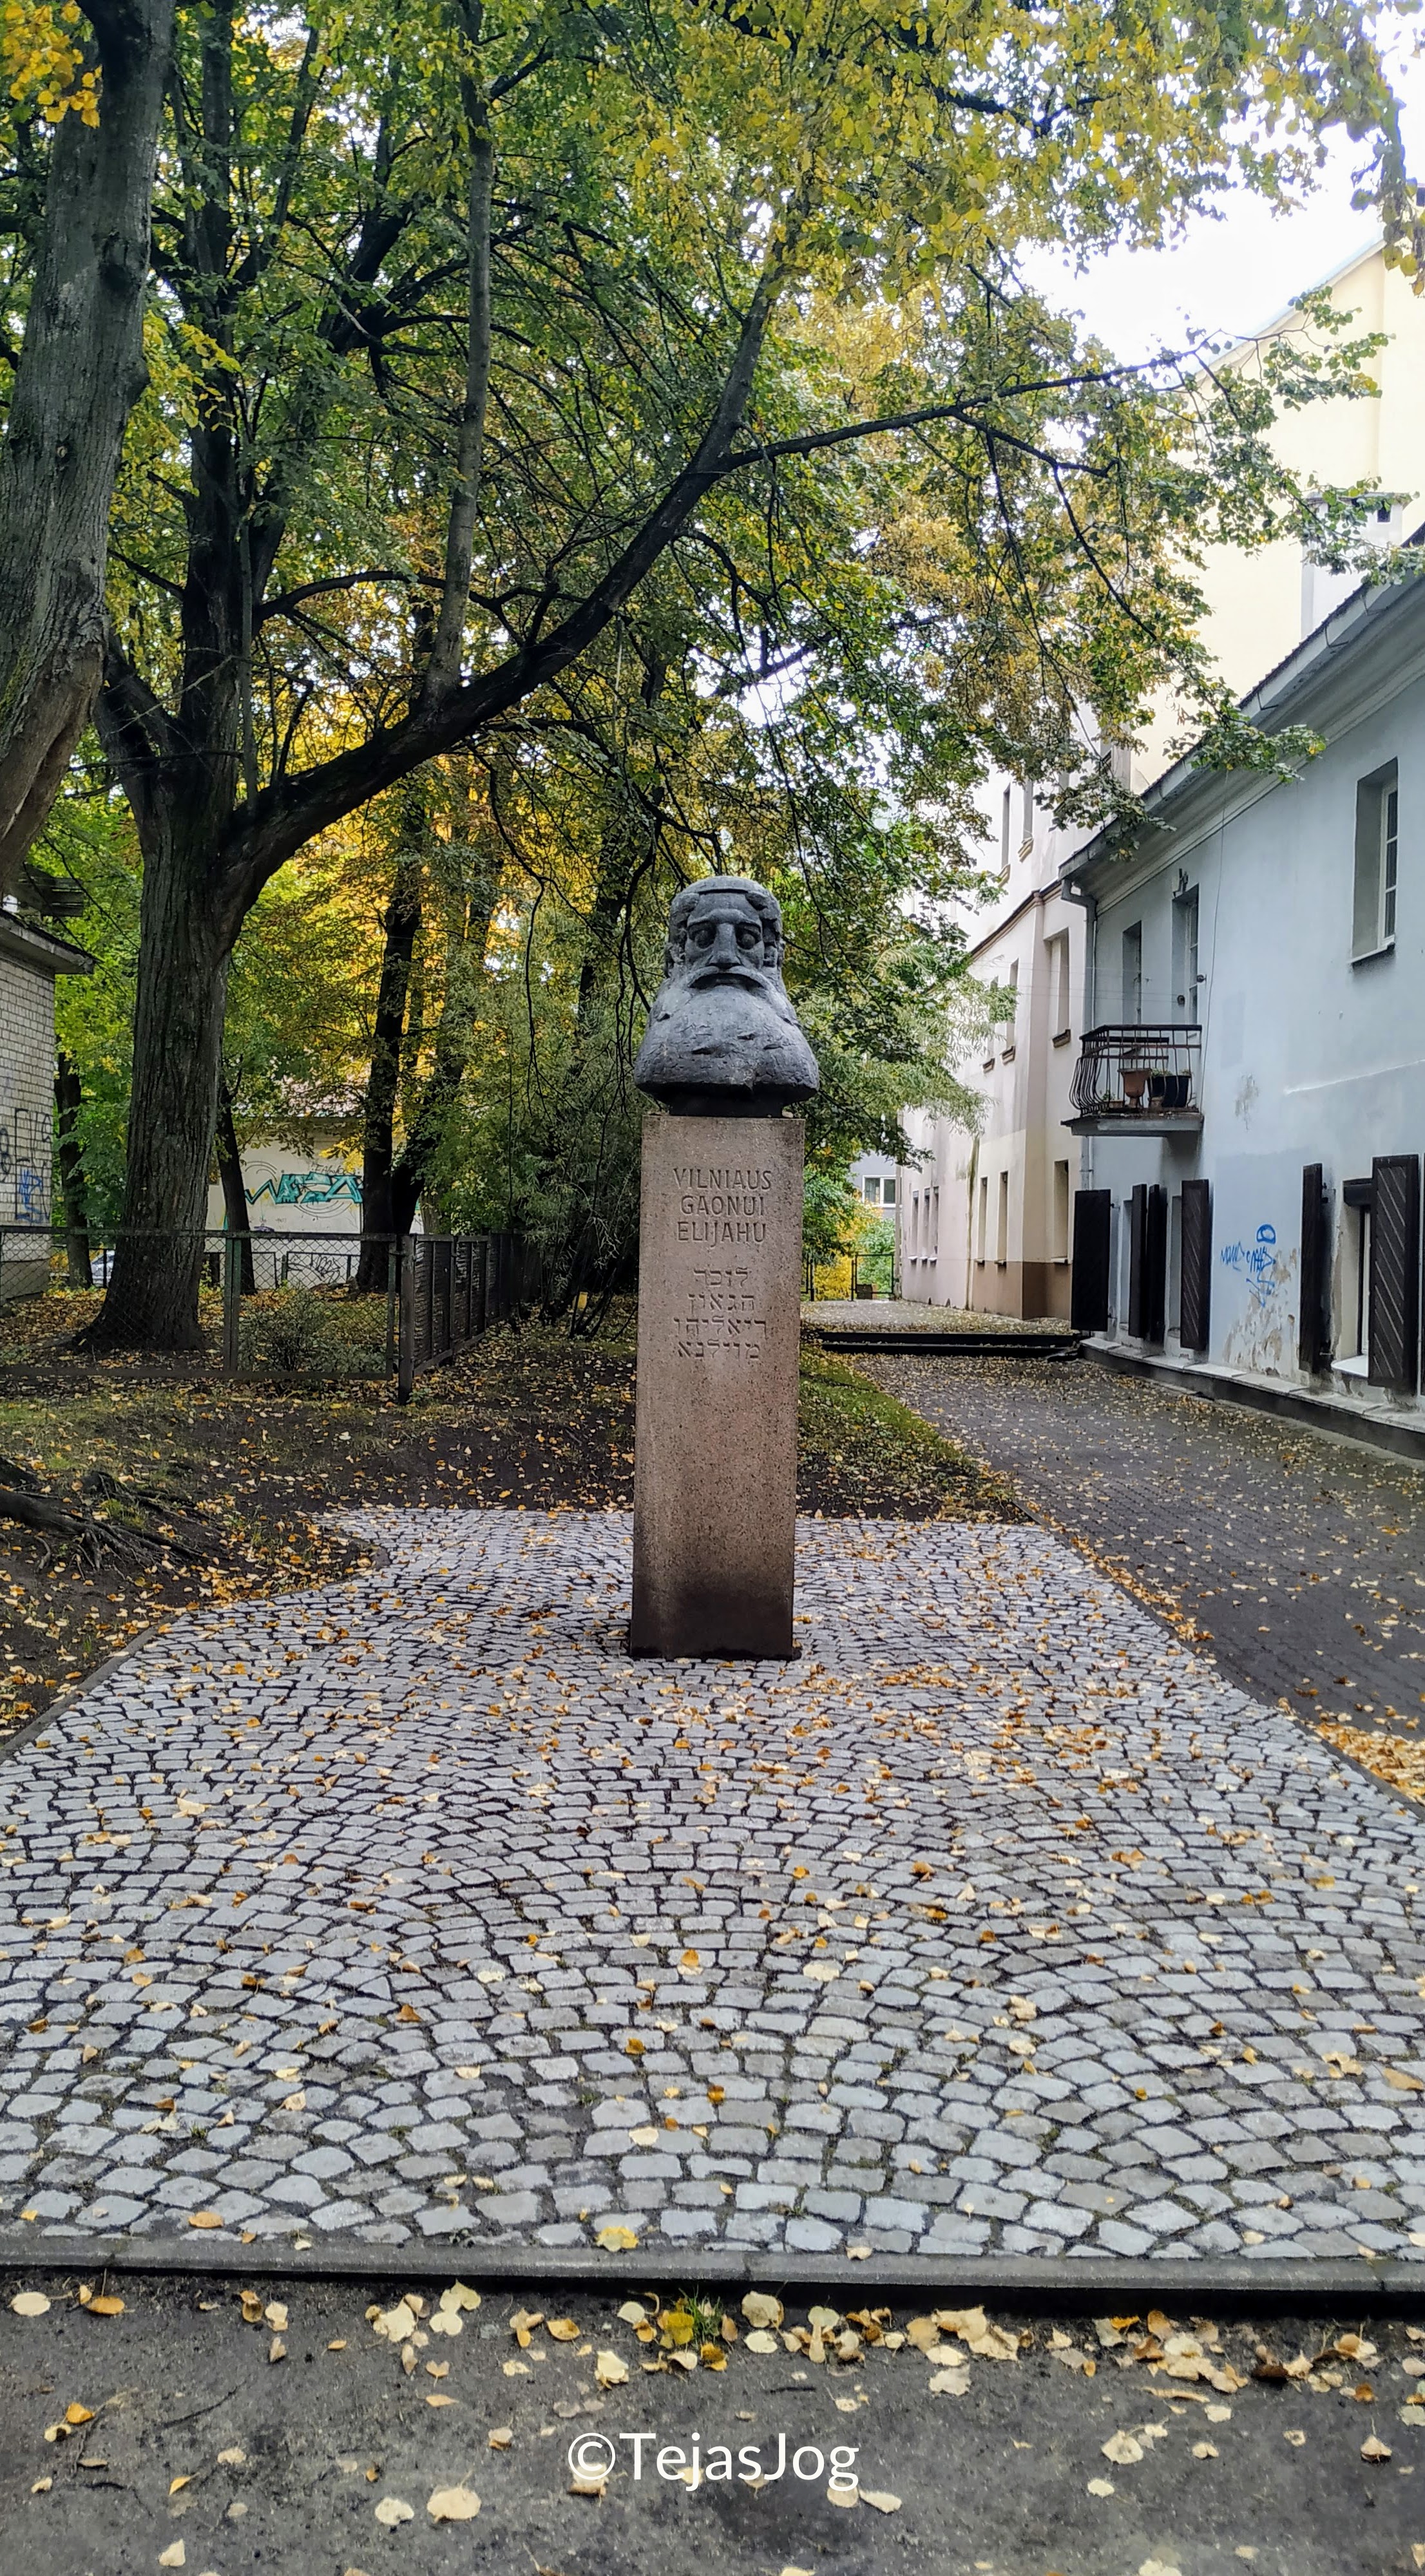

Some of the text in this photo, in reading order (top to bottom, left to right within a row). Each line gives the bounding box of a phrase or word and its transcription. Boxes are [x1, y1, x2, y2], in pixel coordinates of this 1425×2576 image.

[673, 1168, 772, 1191] VILNIAUS
[680, 1195, 764, 1217] GAONUI
[677, 1221, 767, 1249] ELIJAHU
[687, 1293, 755, 1314] הגאון
[677, 1338, 760, 1360] מוילנא
